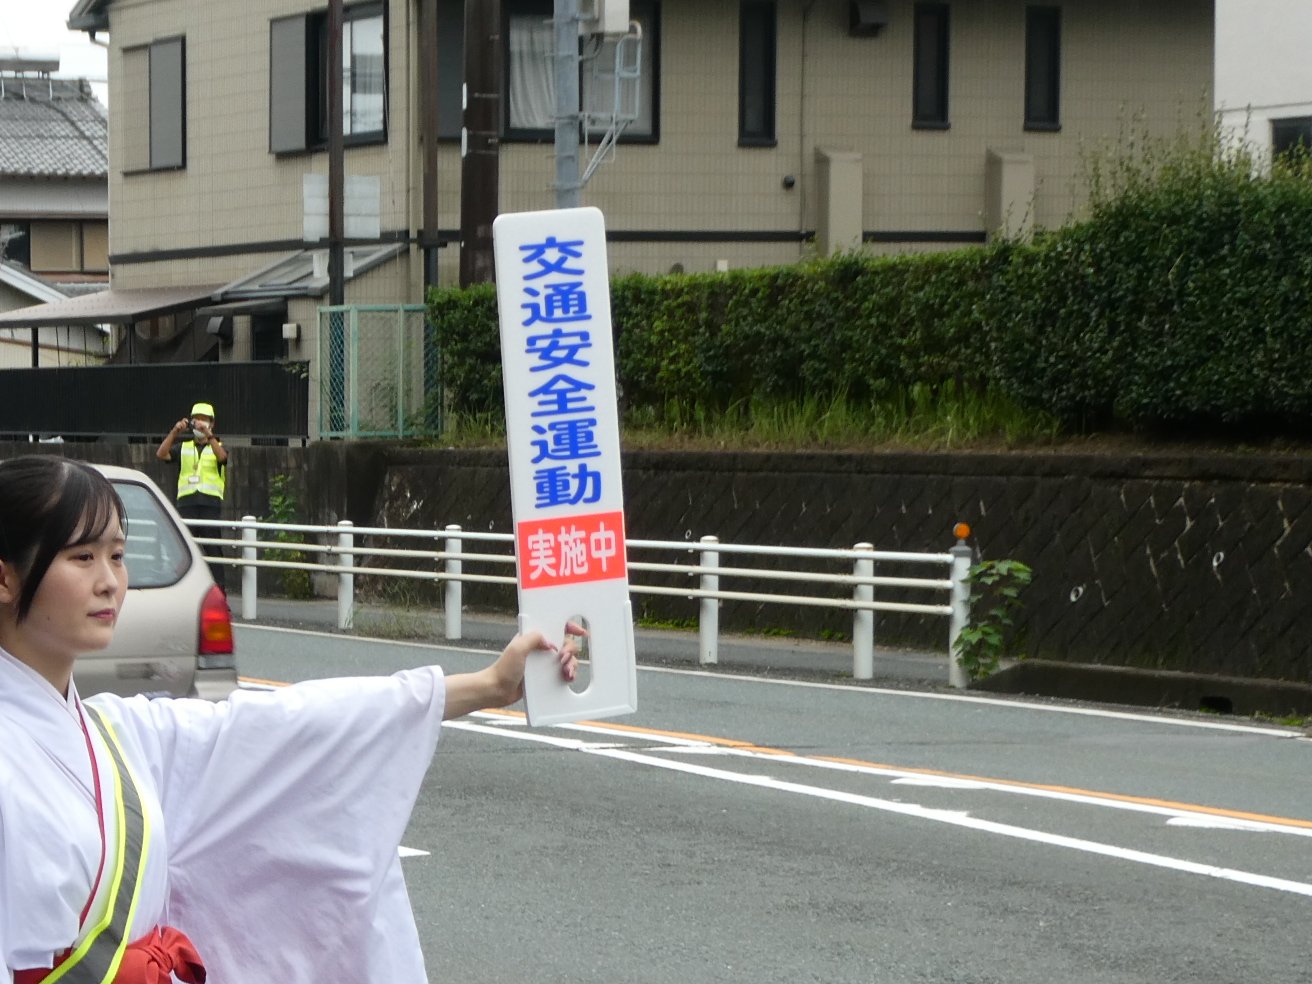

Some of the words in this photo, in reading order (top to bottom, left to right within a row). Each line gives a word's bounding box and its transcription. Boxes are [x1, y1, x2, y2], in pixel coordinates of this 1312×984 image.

[518, 236, 602, 510] 交通安全運動
[526, 521, 617, 582] 実施中
